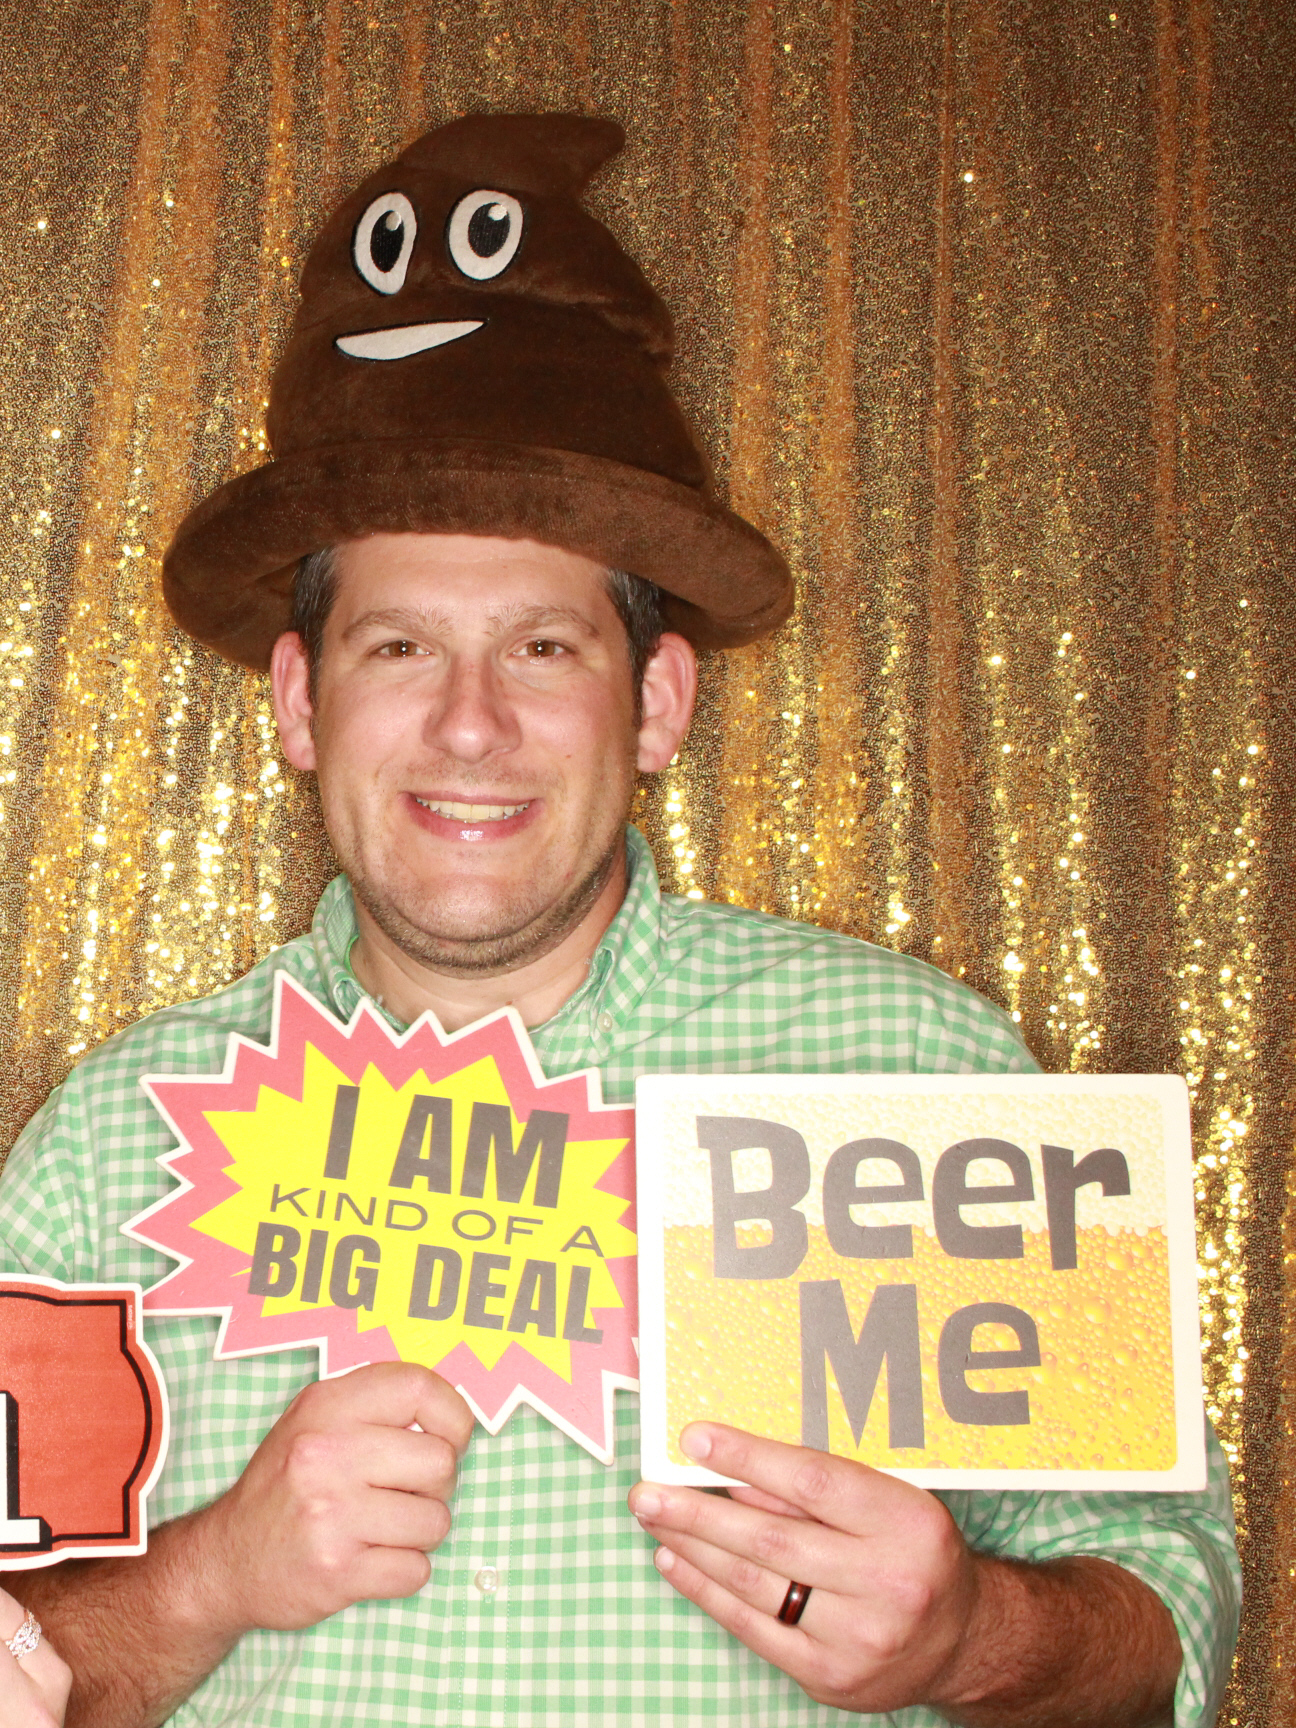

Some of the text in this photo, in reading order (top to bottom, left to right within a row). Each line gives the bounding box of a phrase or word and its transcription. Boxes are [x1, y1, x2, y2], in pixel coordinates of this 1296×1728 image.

[323, 1084, 571, 1209] I AM
[696, 1115, 1131, 1280] Beer
[247, 1221, 604, 1345] BIG DEAL
[269, 1183, 605, 1259] KIND OF A
[798, 1279, 1042, 1454] Me
